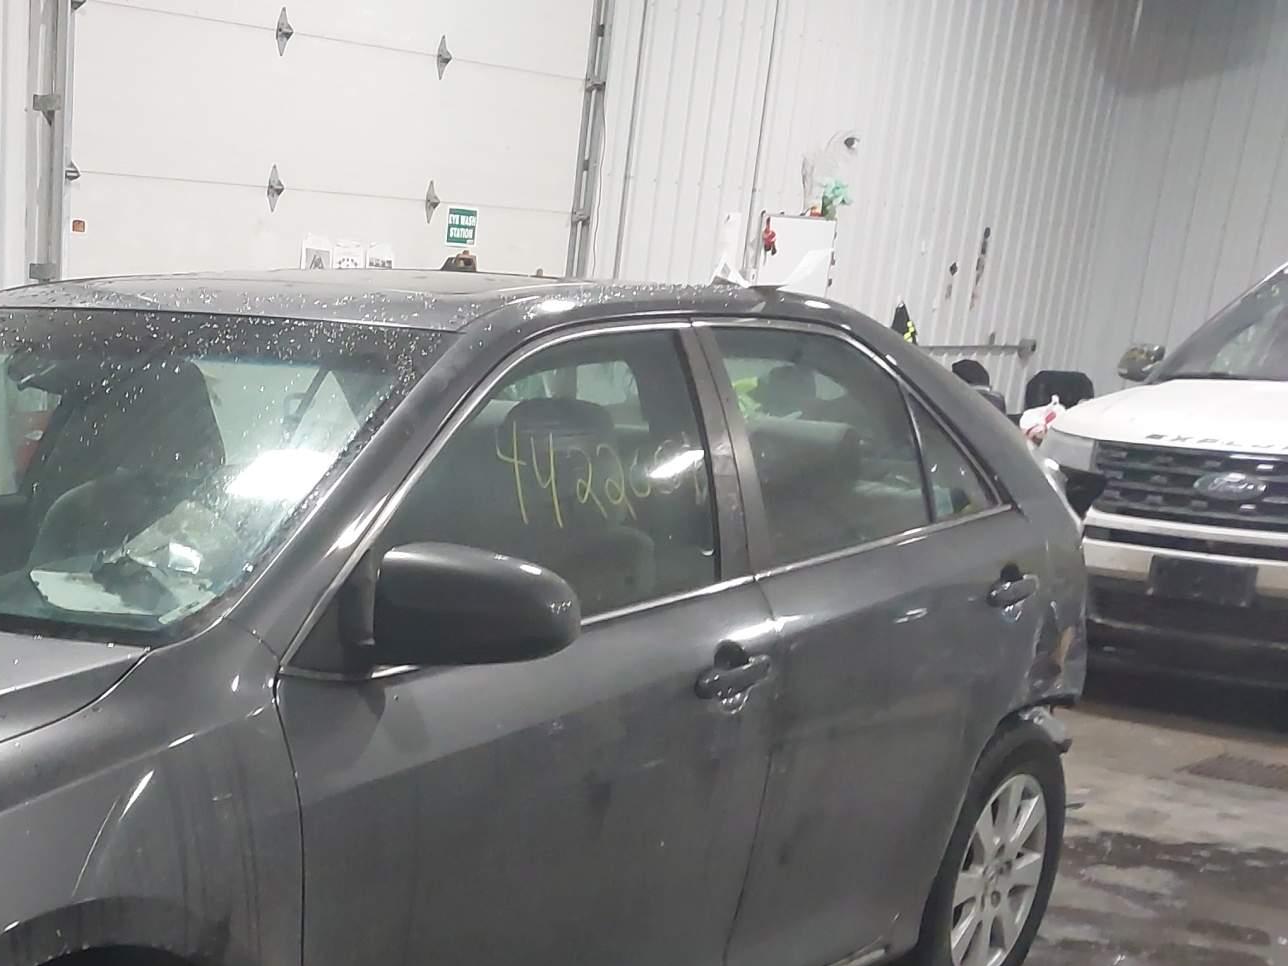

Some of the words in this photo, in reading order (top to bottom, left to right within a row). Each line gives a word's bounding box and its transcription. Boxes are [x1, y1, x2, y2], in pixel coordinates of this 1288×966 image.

[448, 214, 459, 225] EYE
[460, 215, 476, 226] WASH
[449, 227, 474, 239] STATION
